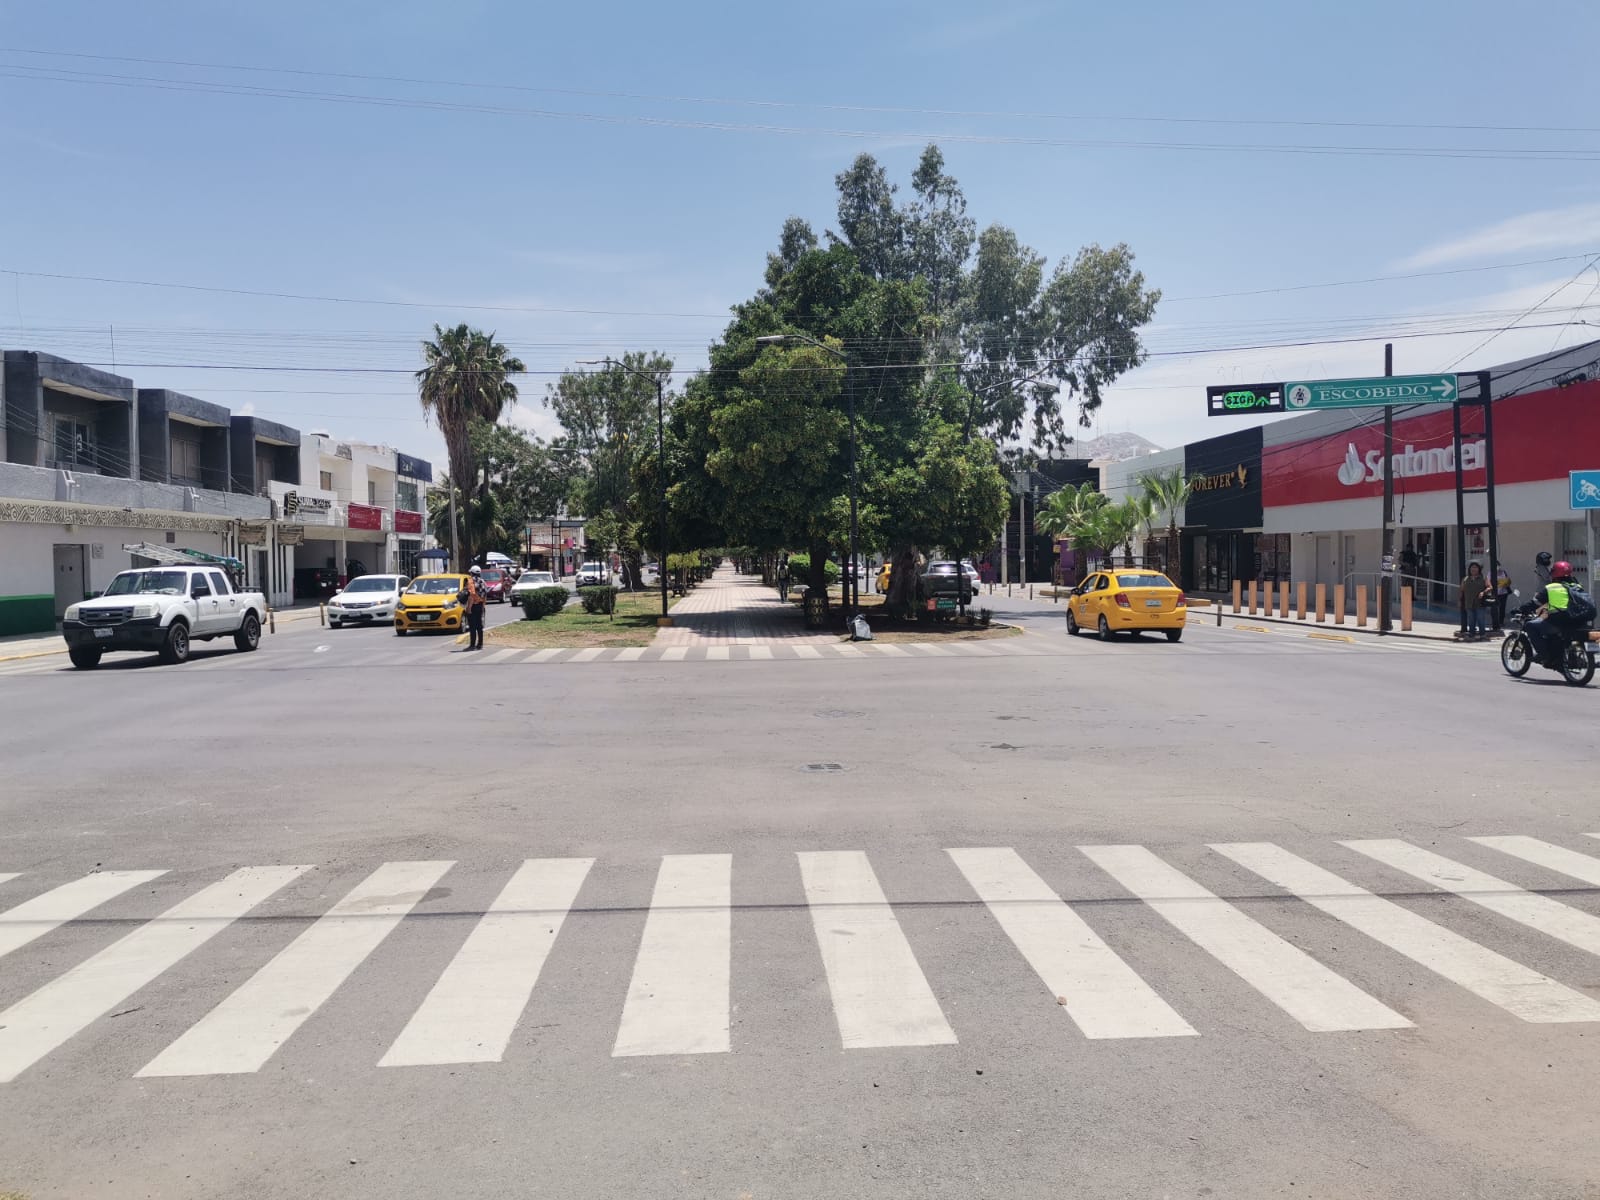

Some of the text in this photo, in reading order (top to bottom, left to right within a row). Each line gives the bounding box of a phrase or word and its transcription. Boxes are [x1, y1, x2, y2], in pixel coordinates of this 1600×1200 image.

[1225, 395, 1254, 405] SIGA
[1318, 385, 1428, 401] ESCOBEDO
[1365, 437, 1486, 482] Santander
